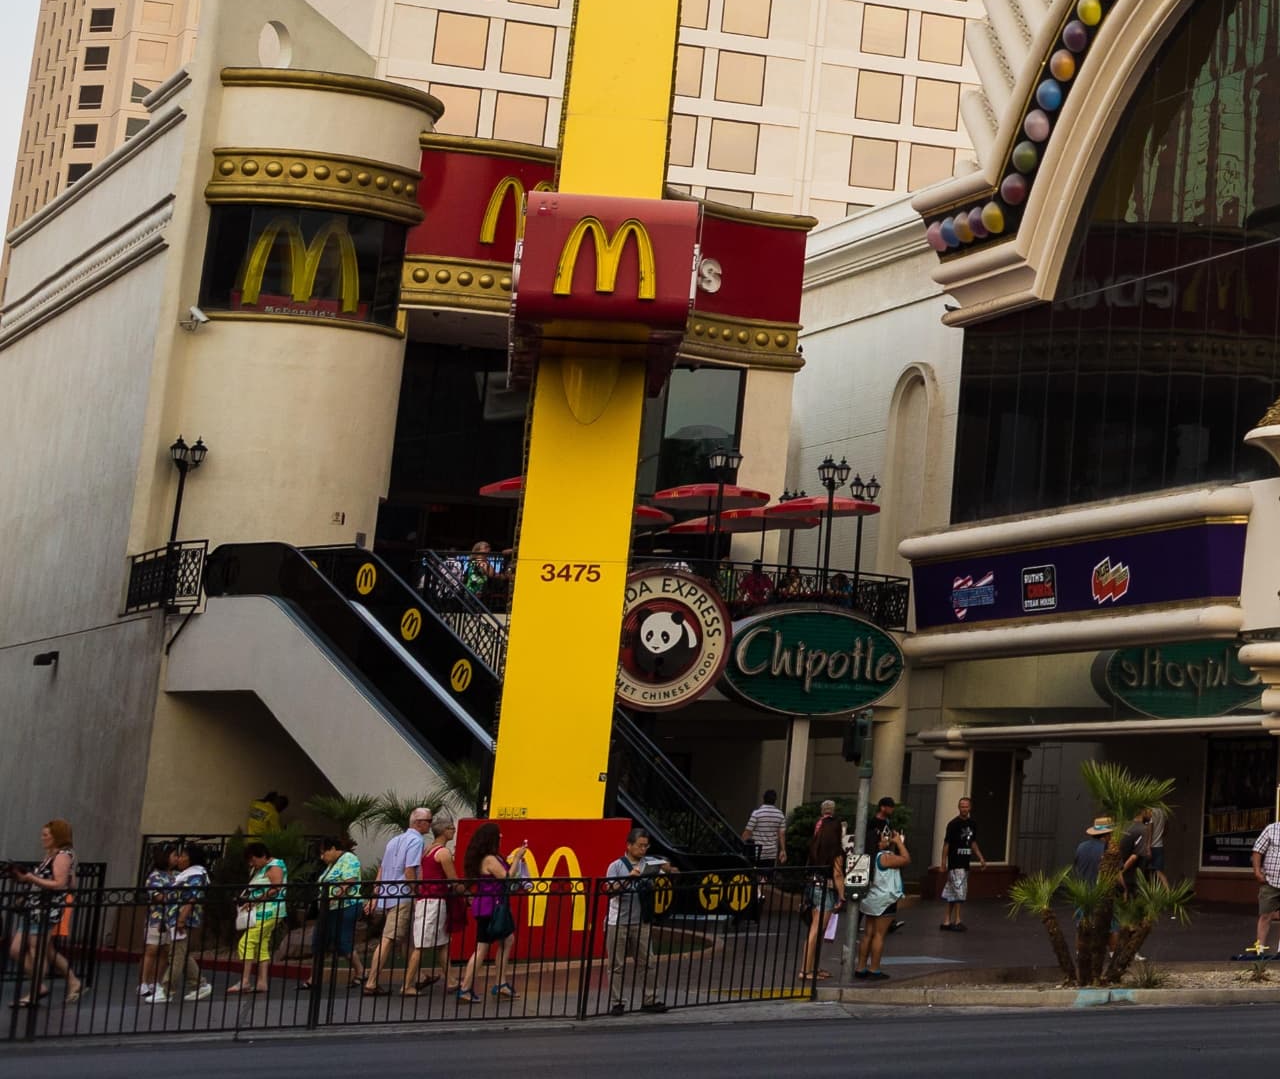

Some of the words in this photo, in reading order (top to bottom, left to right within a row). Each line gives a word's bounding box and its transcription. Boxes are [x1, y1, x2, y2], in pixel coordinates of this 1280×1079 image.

[540, 563, 601, 582] 3475
[1023, 572, 1044, 583] RUTH'S
[661, 577, 722, 638] EXPRESS
[641, 682, 691, 700] CHINESE
[693, 652, 716, 682] FOOD
[736, 627, 897, 694] Chipotle
